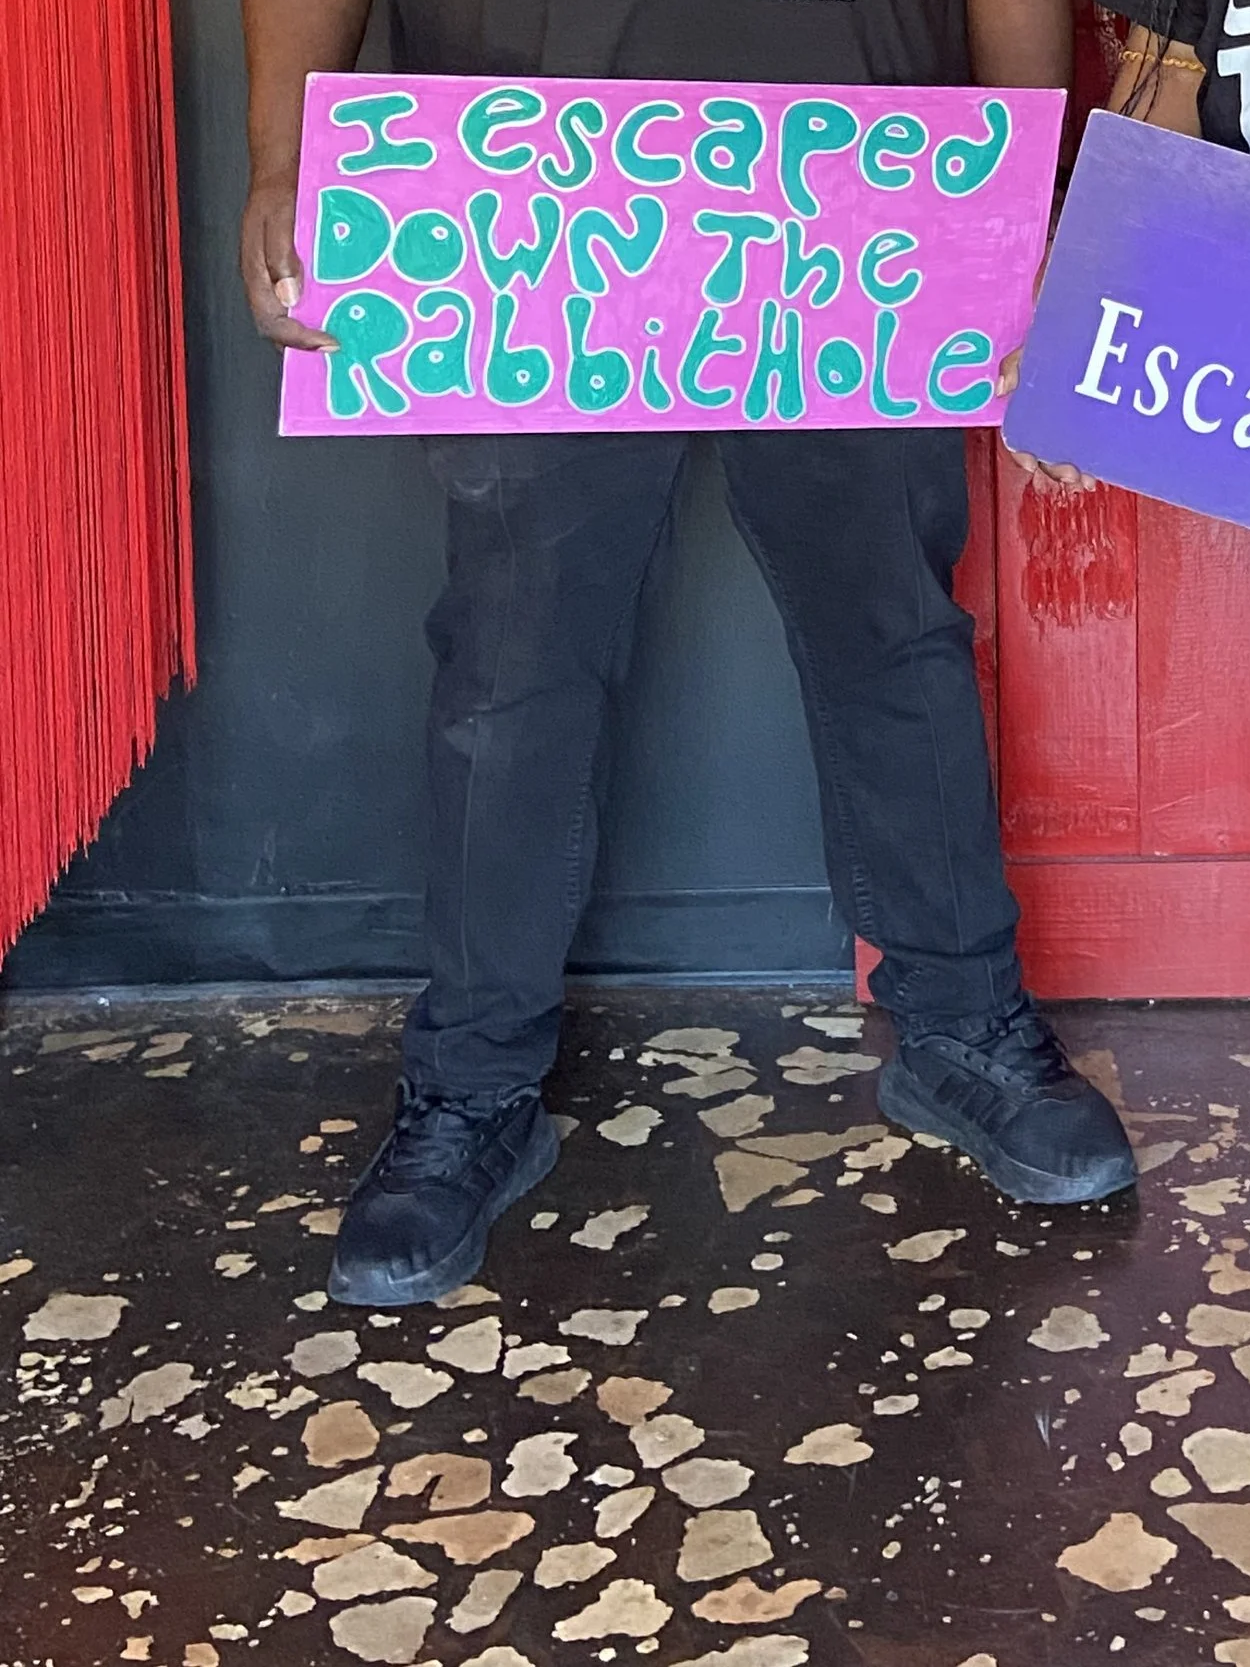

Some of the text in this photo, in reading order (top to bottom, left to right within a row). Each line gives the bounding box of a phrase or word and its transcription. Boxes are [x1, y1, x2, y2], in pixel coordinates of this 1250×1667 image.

[330, 86, 1012, 218] I escaped
[694, 209, 923, 309] The
